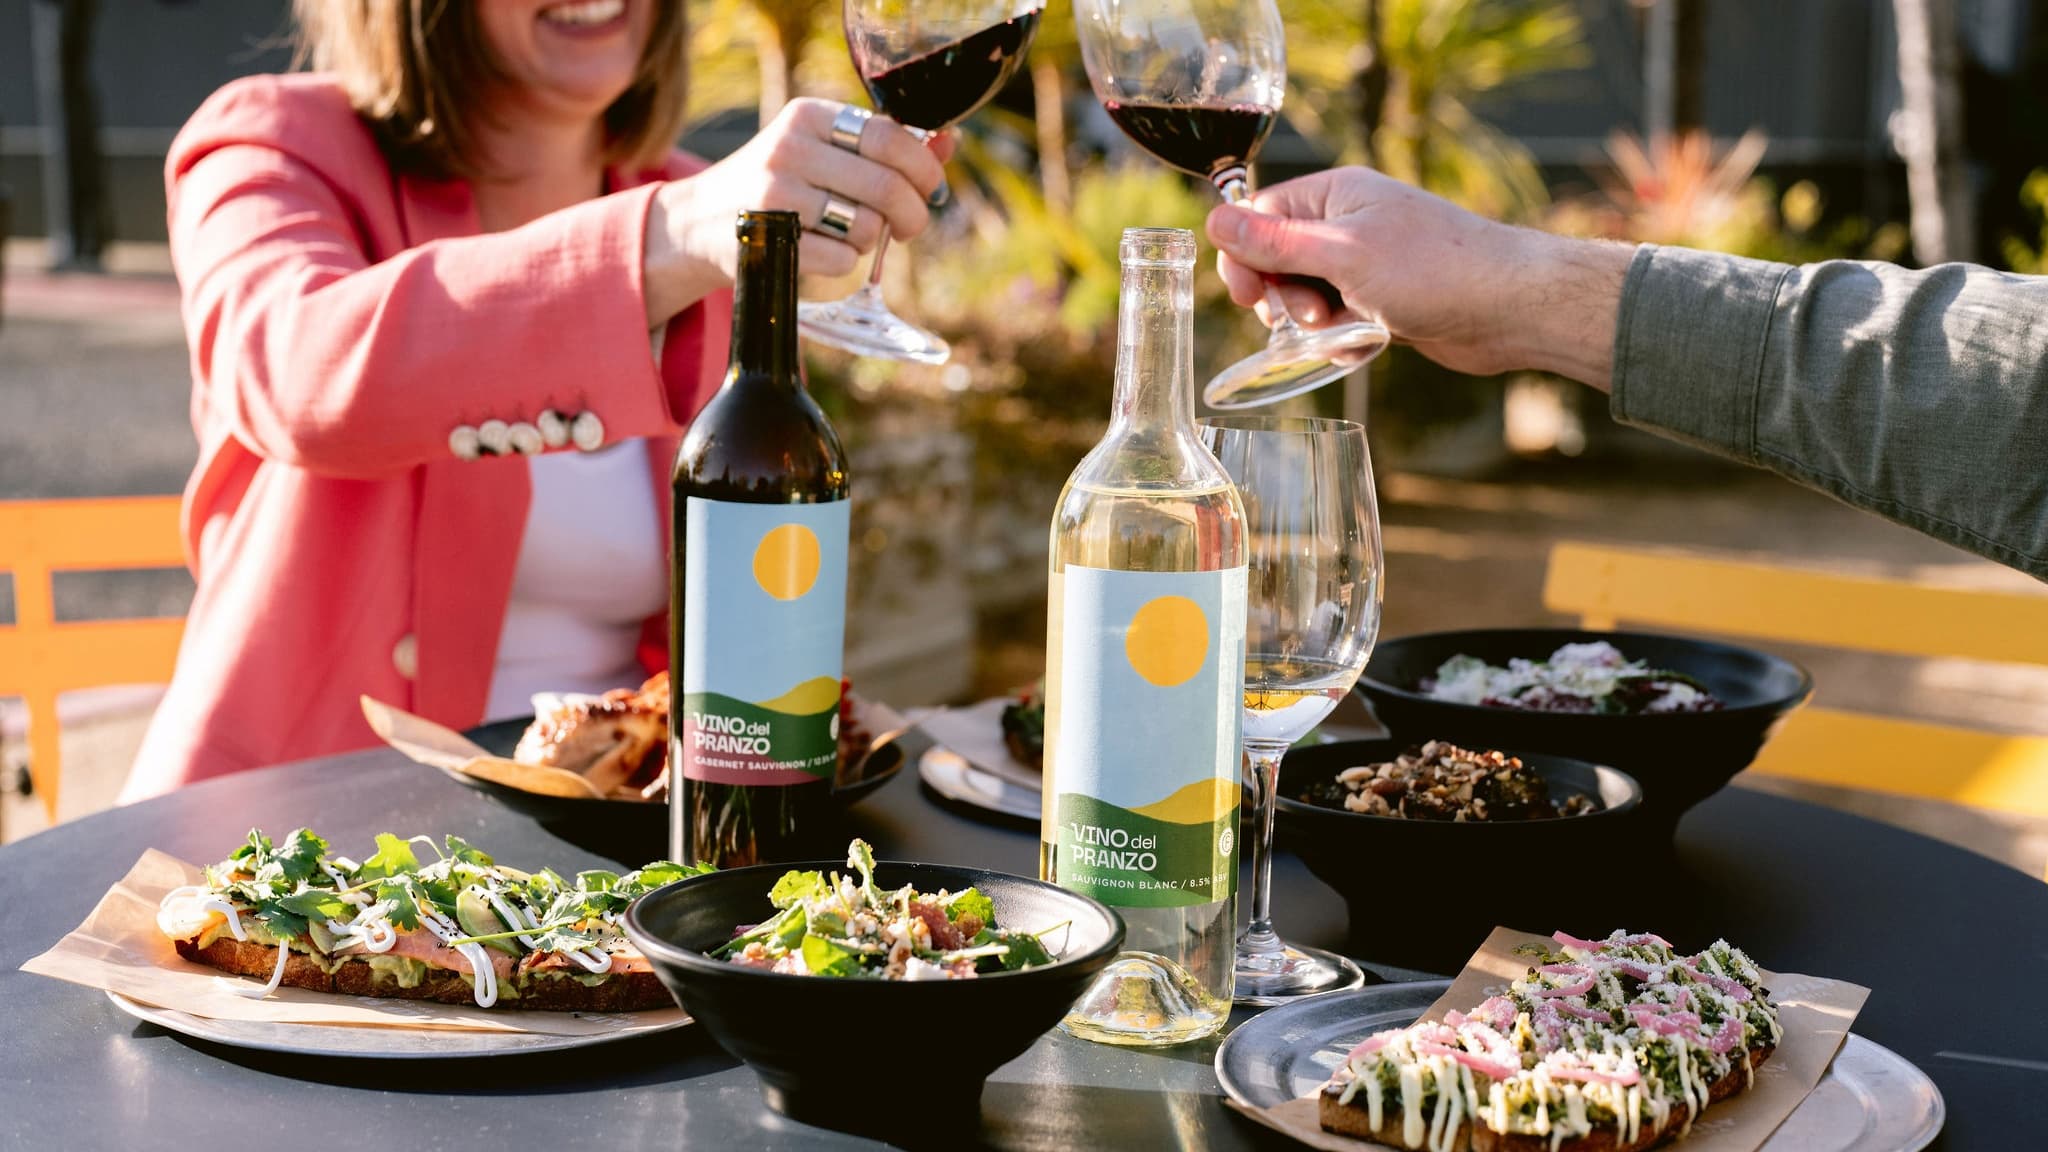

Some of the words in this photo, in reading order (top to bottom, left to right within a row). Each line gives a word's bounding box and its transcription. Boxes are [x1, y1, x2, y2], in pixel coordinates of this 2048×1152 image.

[693, 712, 745, 735] VINO
[747, 722, 770, 736] del
[693, 731, 771, 755] PRANZO
[694, 756, 744, 770] CABERNET
[748, 760, 806, 770] SAUVIGNON
[1071, 822, 1129, 849] VINO
[1131, 834, 1157, 850] del
[1070, 844, 1157, 872] PRANZO
[1072, 873, 1135, 889] SAUVIGNON
[1139, 880, 1178, 890] BLANC
[1180, 879, 1187, 890] /
[1190, 876, 1211, 888] 8.5%
